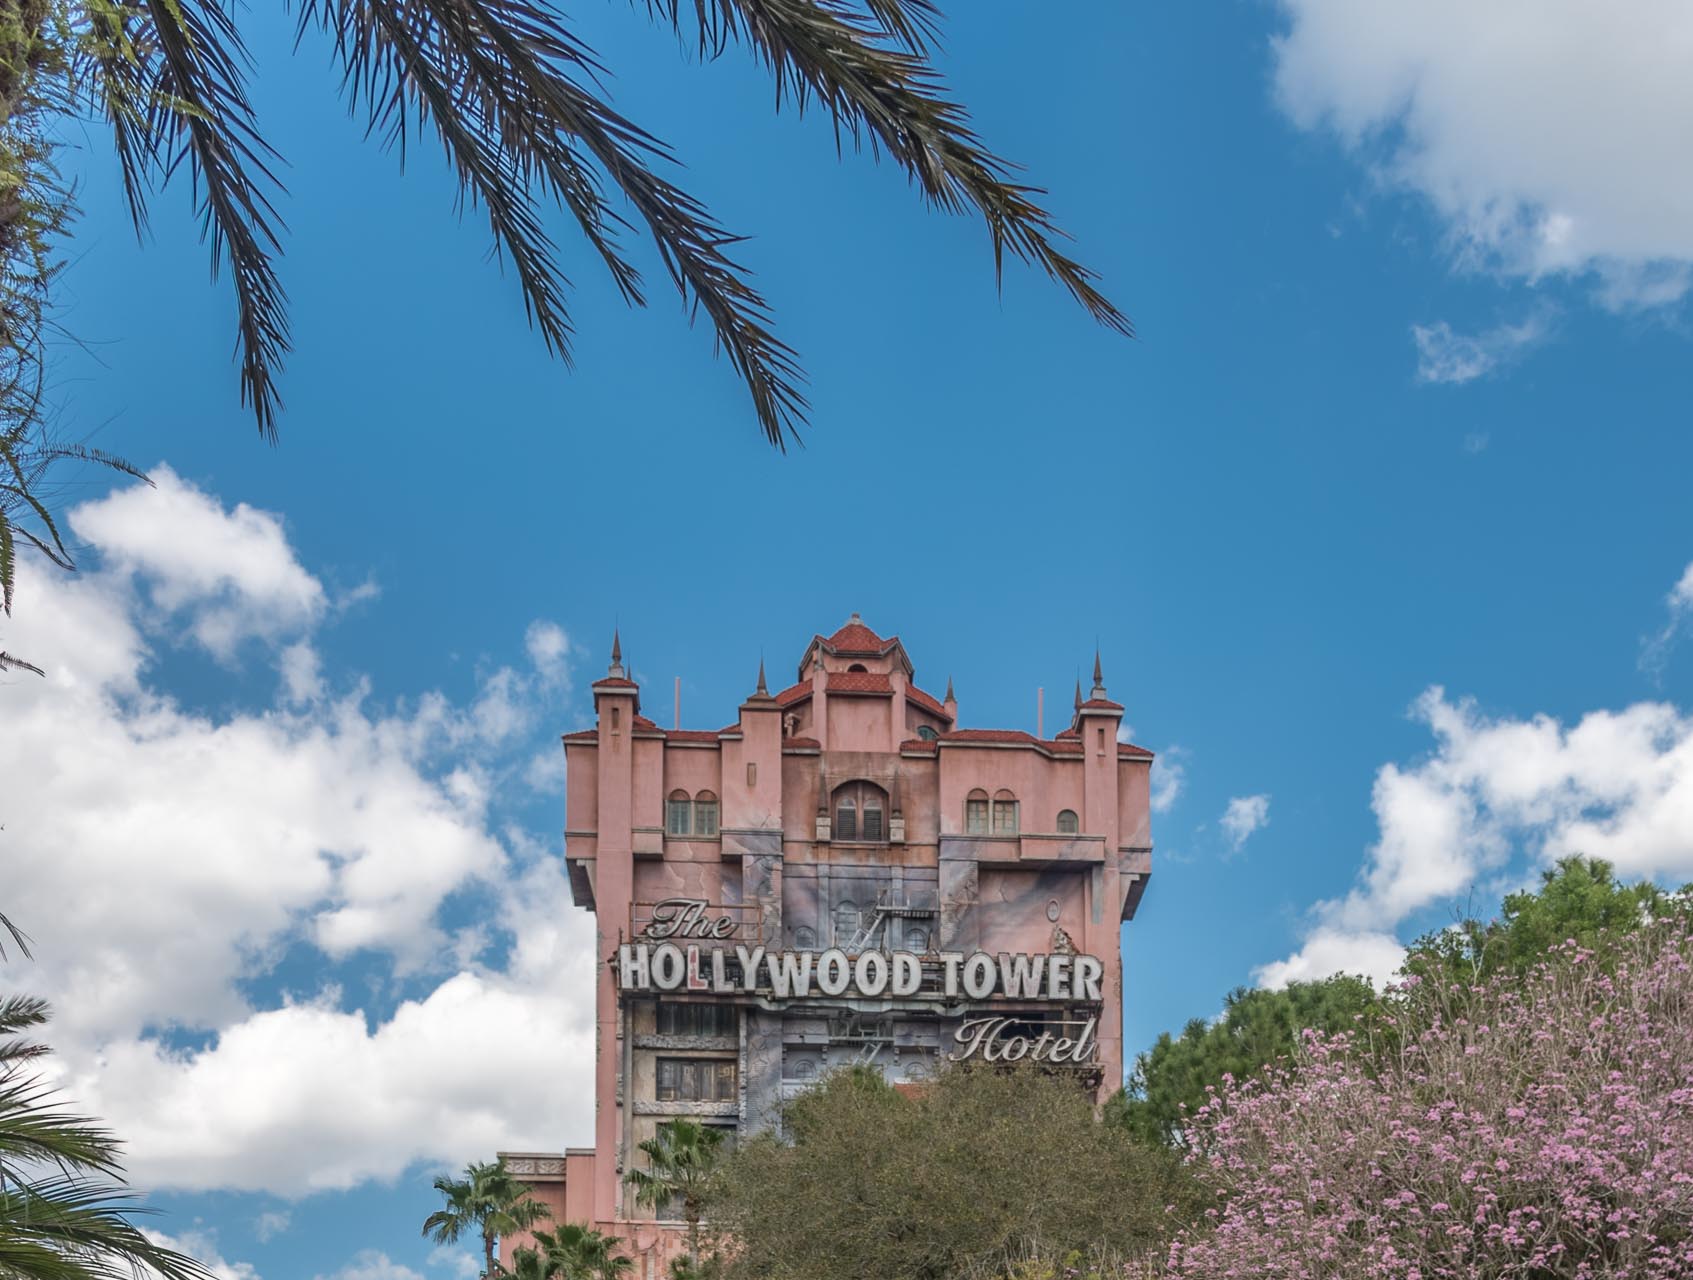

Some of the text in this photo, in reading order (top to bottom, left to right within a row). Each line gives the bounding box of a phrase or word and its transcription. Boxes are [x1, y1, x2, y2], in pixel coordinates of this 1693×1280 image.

[646, 898, 739, 939] The
[619, 944, 1104, 1001] HOLLYWOOD TOWER
[949, 1016, 1096, 1063] Hotel
